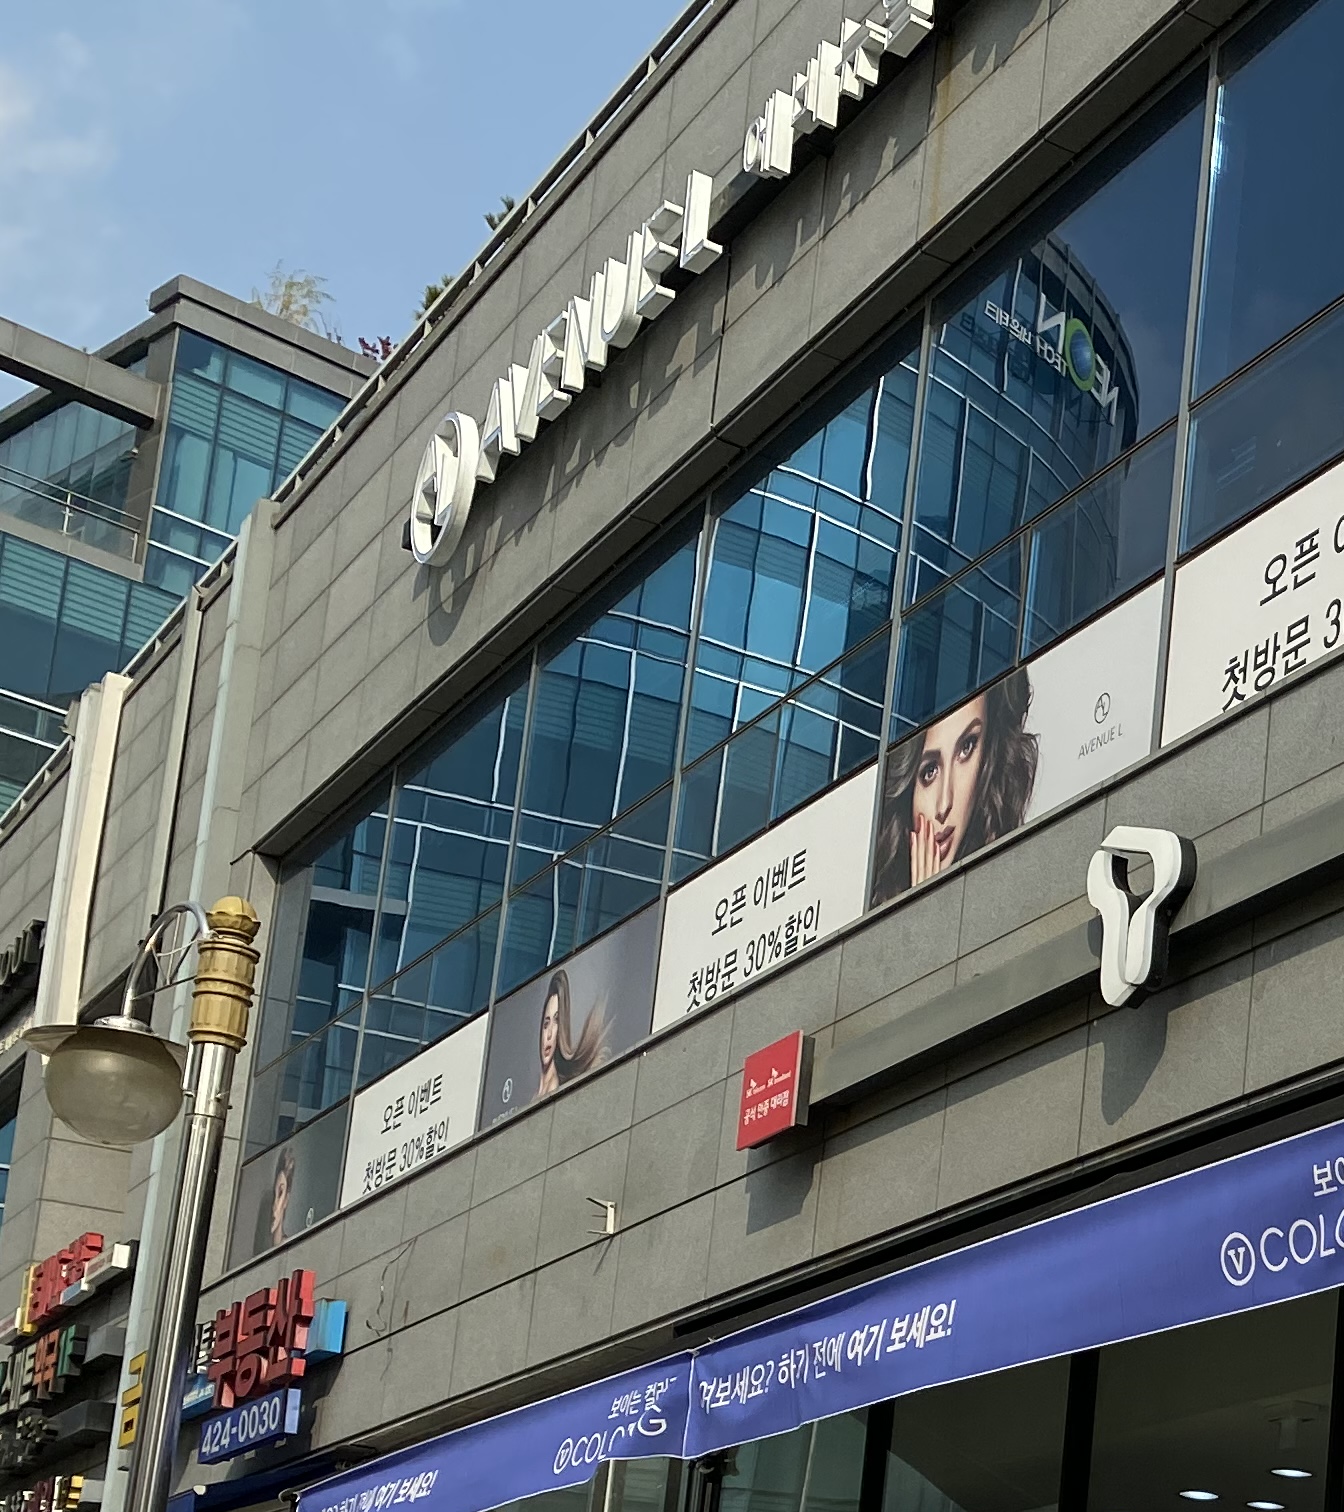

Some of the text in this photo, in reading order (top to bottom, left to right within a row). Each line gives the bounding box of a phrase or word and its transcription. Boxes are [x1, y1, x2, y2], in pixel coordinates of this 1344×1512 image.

[1260, 525, 1321, 606] 오픈
[1223, 615, 1311, 712] 첫방문
[712, 848, 807, 938] 오픈 이벤트
[687, 955, 738, 1013] 첫방문
[381, 1095, 405, 1134] 오픈
[407, 1074, 443, 1118] 이벤트
[363, 1147, 397, 1195] 첫방문
[778, 1300, 957, 1388] 하기 전에 여기 보세요!
[202, 1396, 281, 1457] 424-0030
